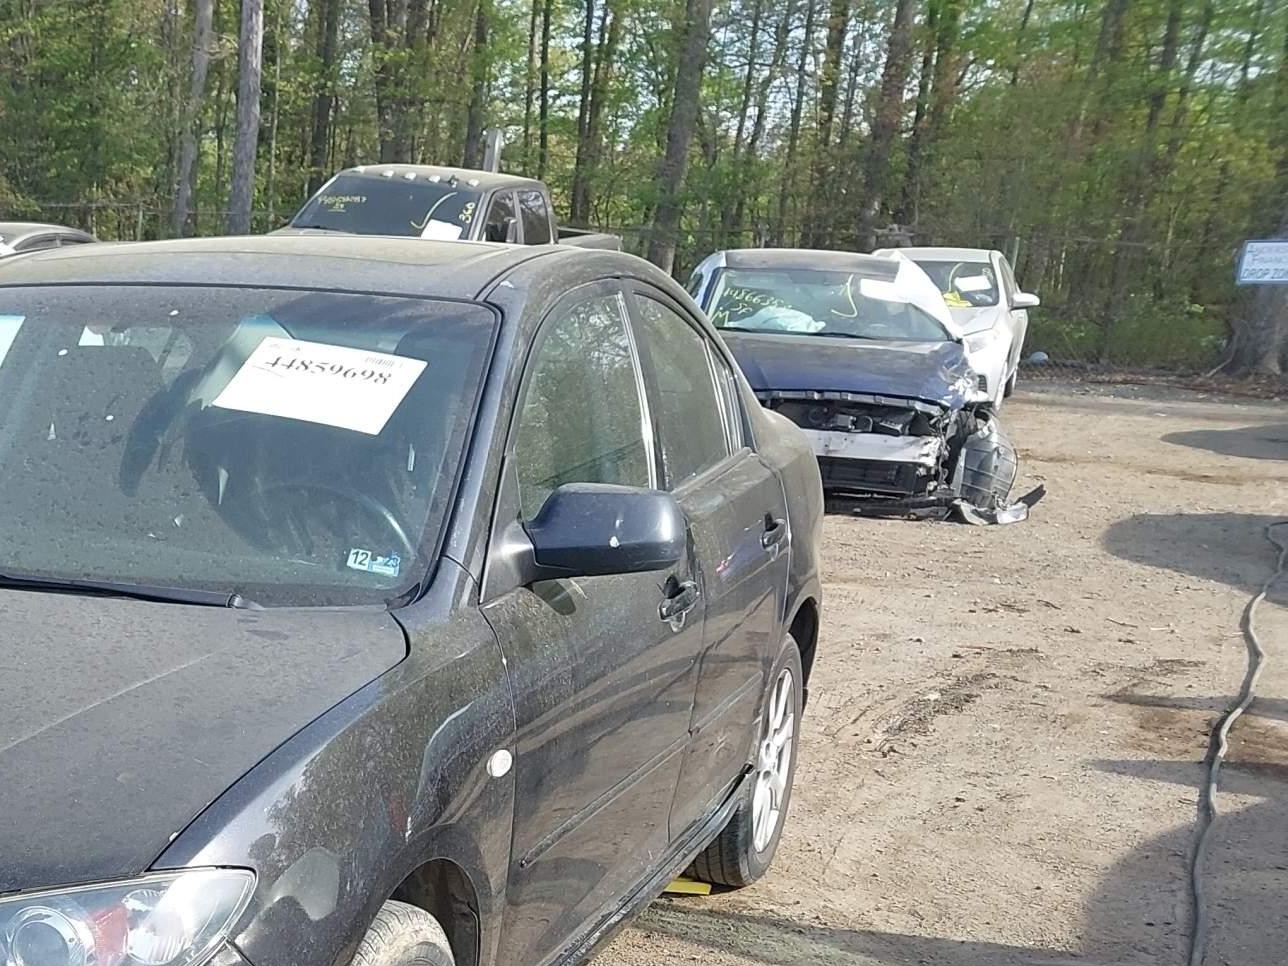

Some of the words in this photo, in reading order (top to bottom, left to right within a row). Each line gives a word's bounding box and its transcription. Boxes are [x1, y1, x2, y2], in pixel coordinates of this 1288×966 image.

[1271, 268, 1288, 279] ZO
[265, 355, 392, 384] 44859698
[352, 550, 369, 566] 12
